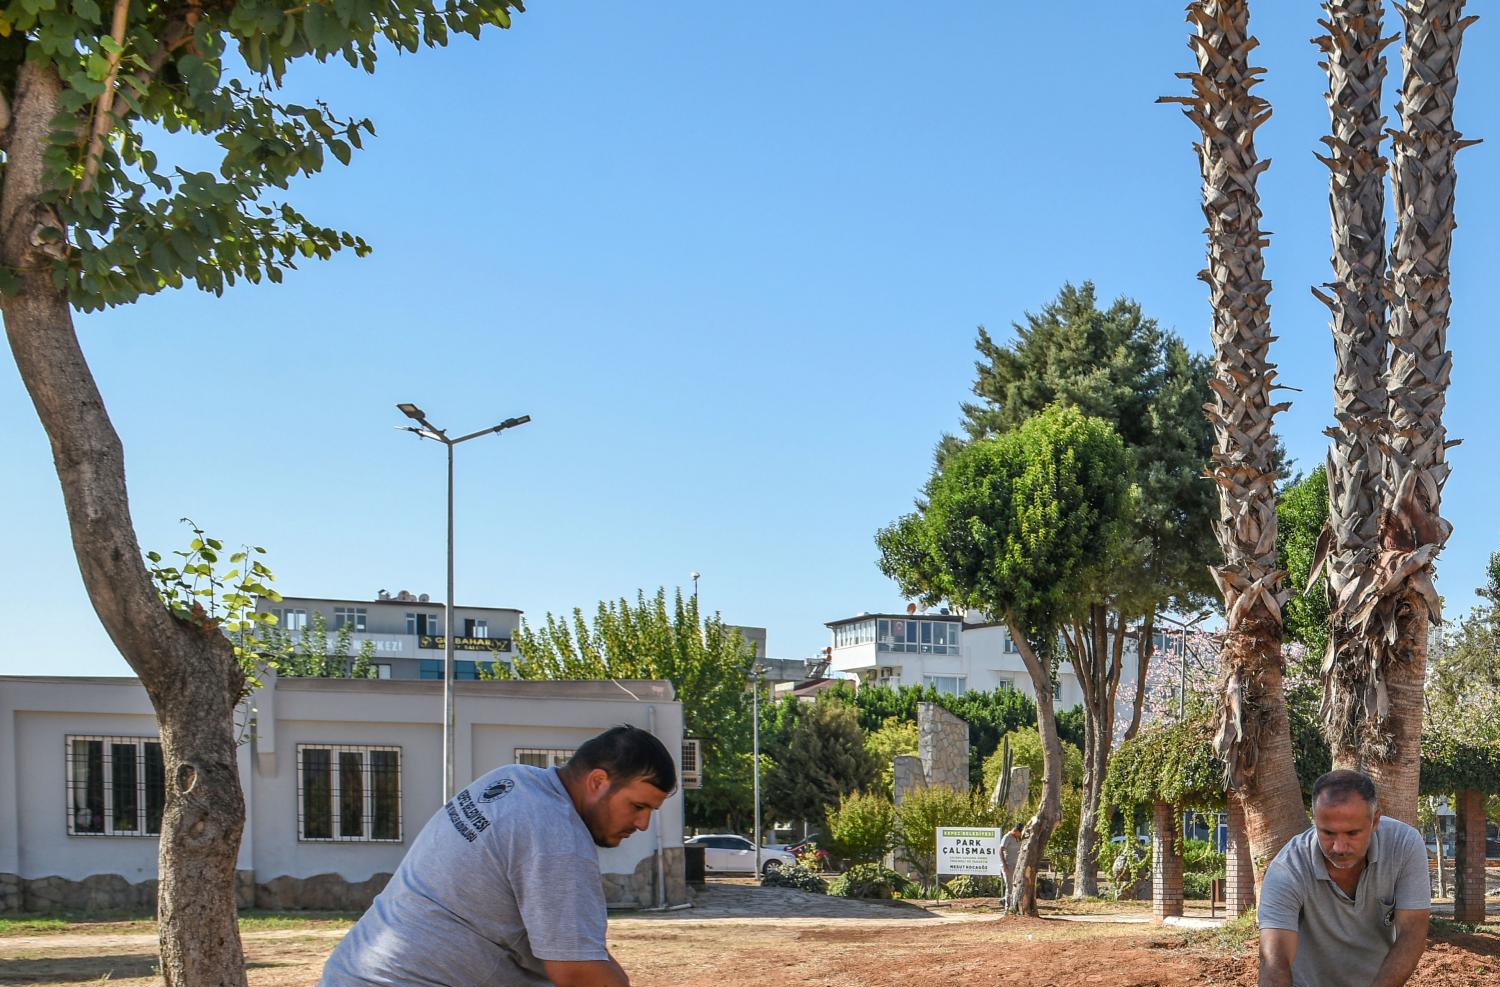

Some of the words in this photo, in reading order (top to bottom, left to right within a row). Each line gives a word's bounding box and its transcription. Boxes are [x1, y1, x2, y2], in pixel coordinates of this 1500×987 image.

[434, 636, 491, 645] GBAHAR
[353, 640, 403, 652] MKEZİ
[956, 839, 982, 847] PARK
[942, 847, 996, 856] ÇALIŞMASI
